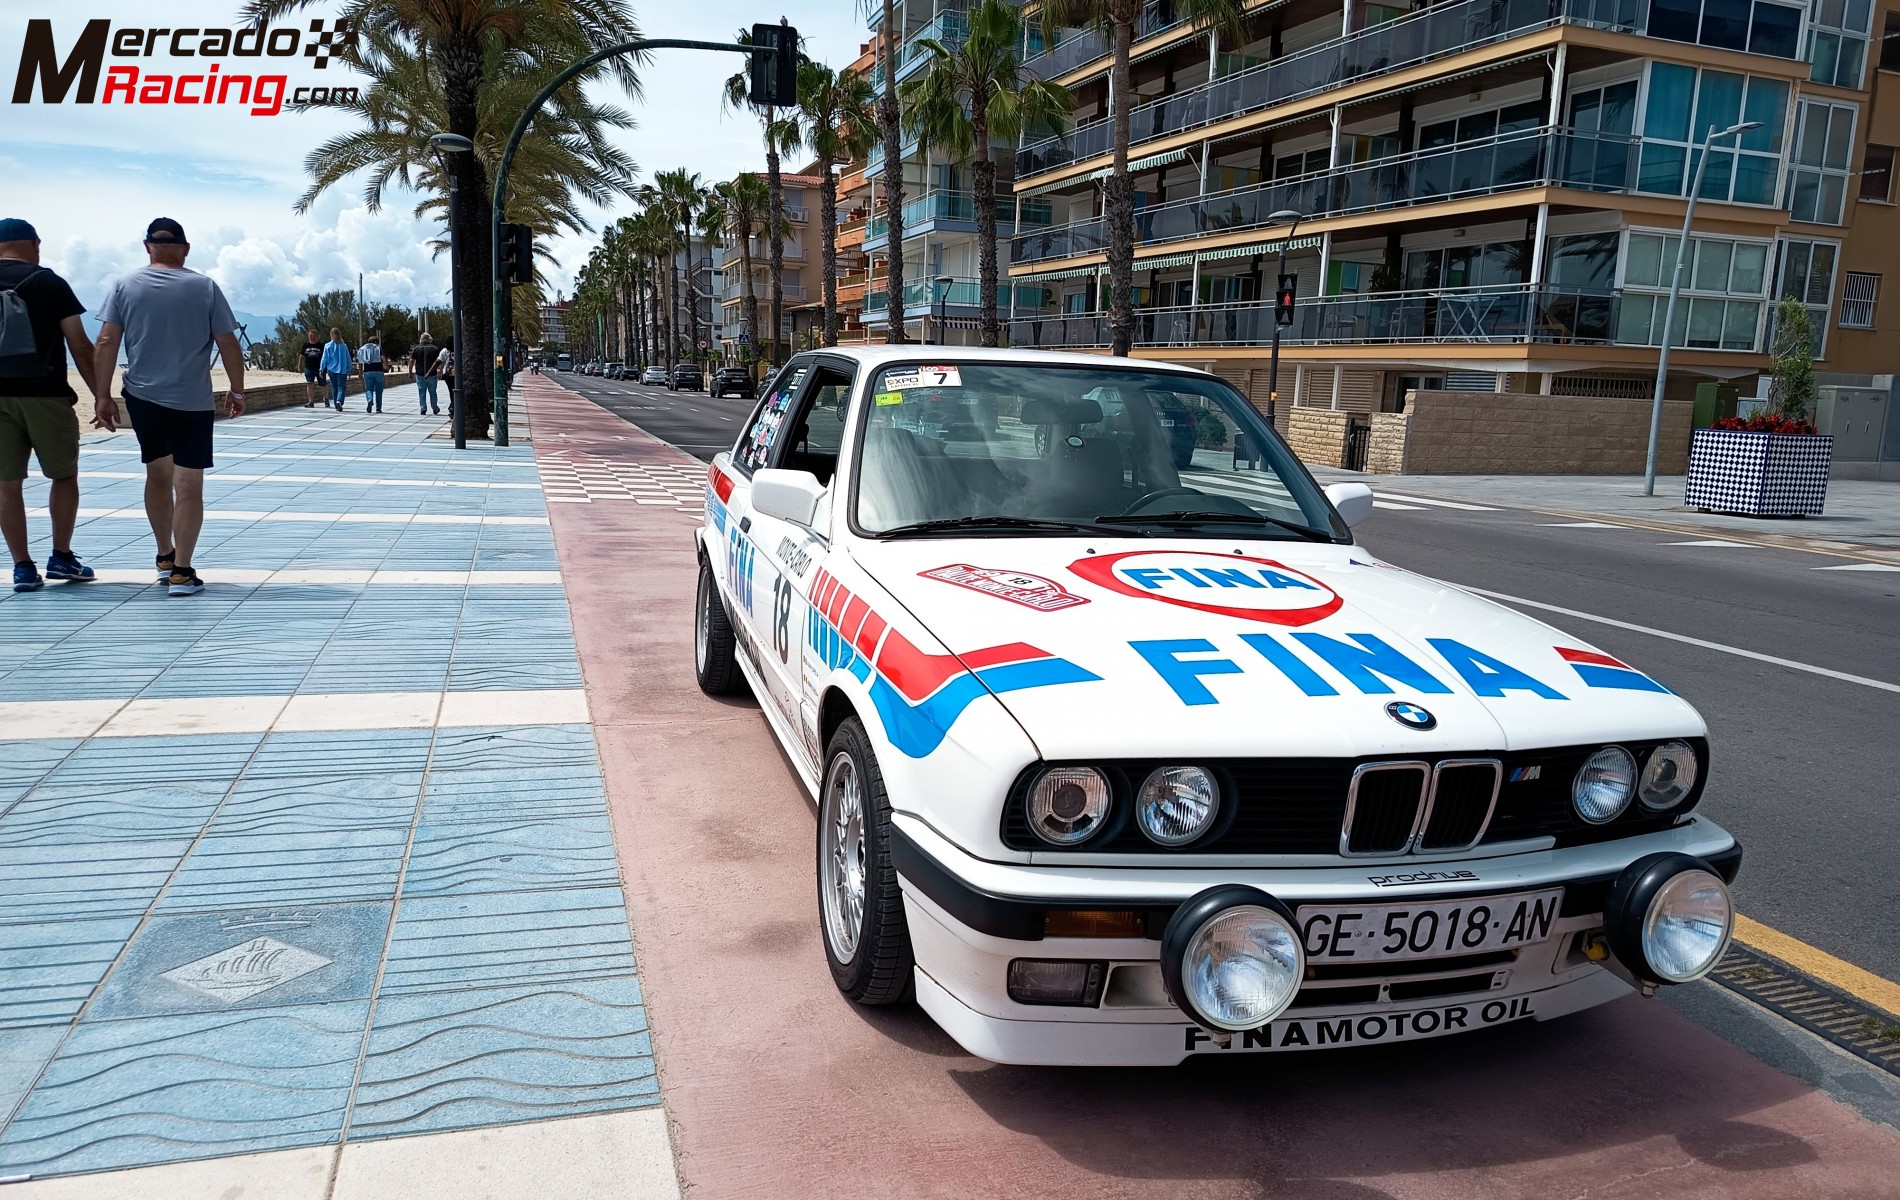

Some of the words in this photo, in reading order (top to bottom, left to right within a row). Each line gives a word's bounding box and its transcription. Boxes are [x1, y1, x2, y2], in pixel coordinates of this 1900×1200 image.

[934, 372, 948, 385] 7
[729, 526, 755, 619] FINA
[1007, 577, 1034, 585] 18
[1119, 567, 1320, 591] FINA
[774, 572, 792, 665] 18
[1126, 632, 1571, 706] FINA
[1367, 869, 1477, 887] prodrive
[1481, 997, 1535, 1024] OIL
